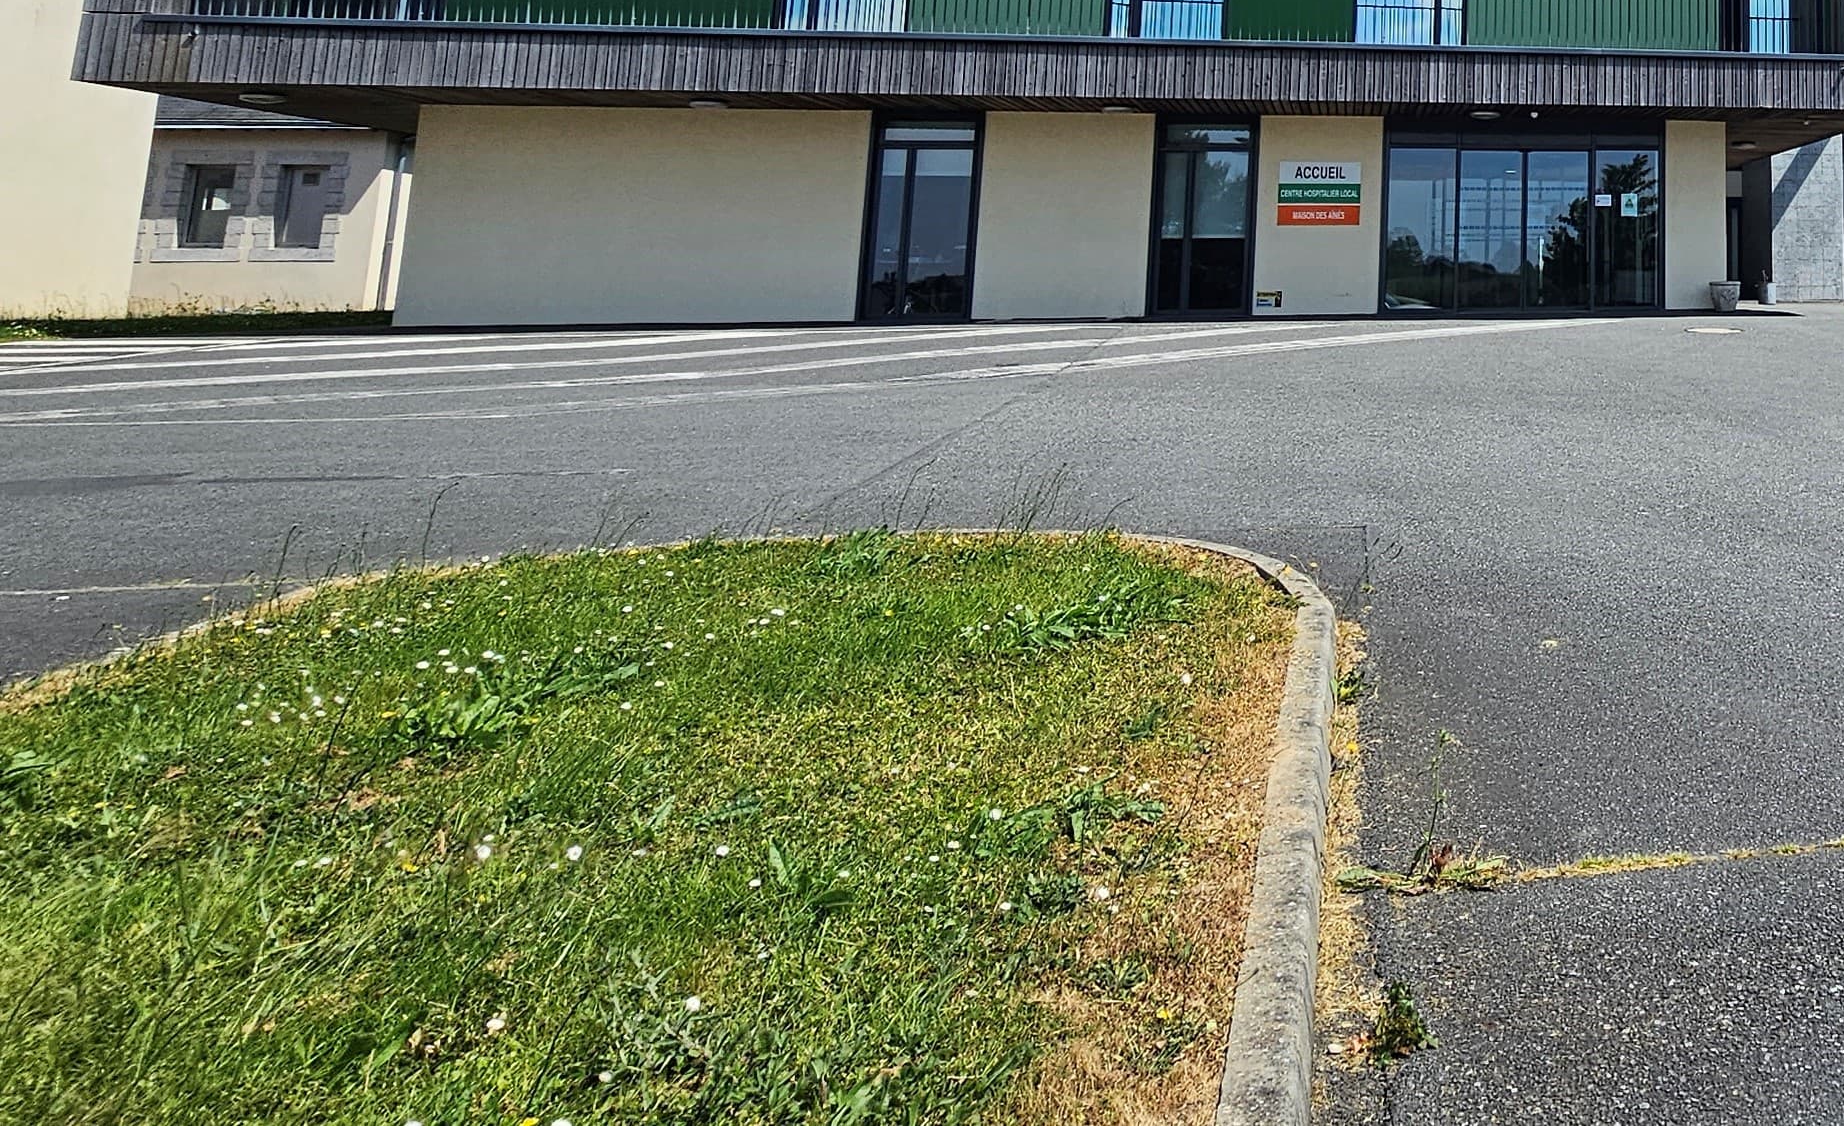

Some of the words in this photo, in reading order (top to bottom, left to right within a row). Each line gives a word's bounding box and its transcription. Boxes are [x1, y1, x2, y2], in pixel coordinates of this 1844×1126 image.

[1294, 166, 1346, 179] ACCUEIL
[1280, 189, 1303, 198] CENTRE
[1303, 189, 1339, 198] HOSPITALIER
[1340, 189, 1359, 198] LOCAL
[1315, 211, 1327, 220] DES
